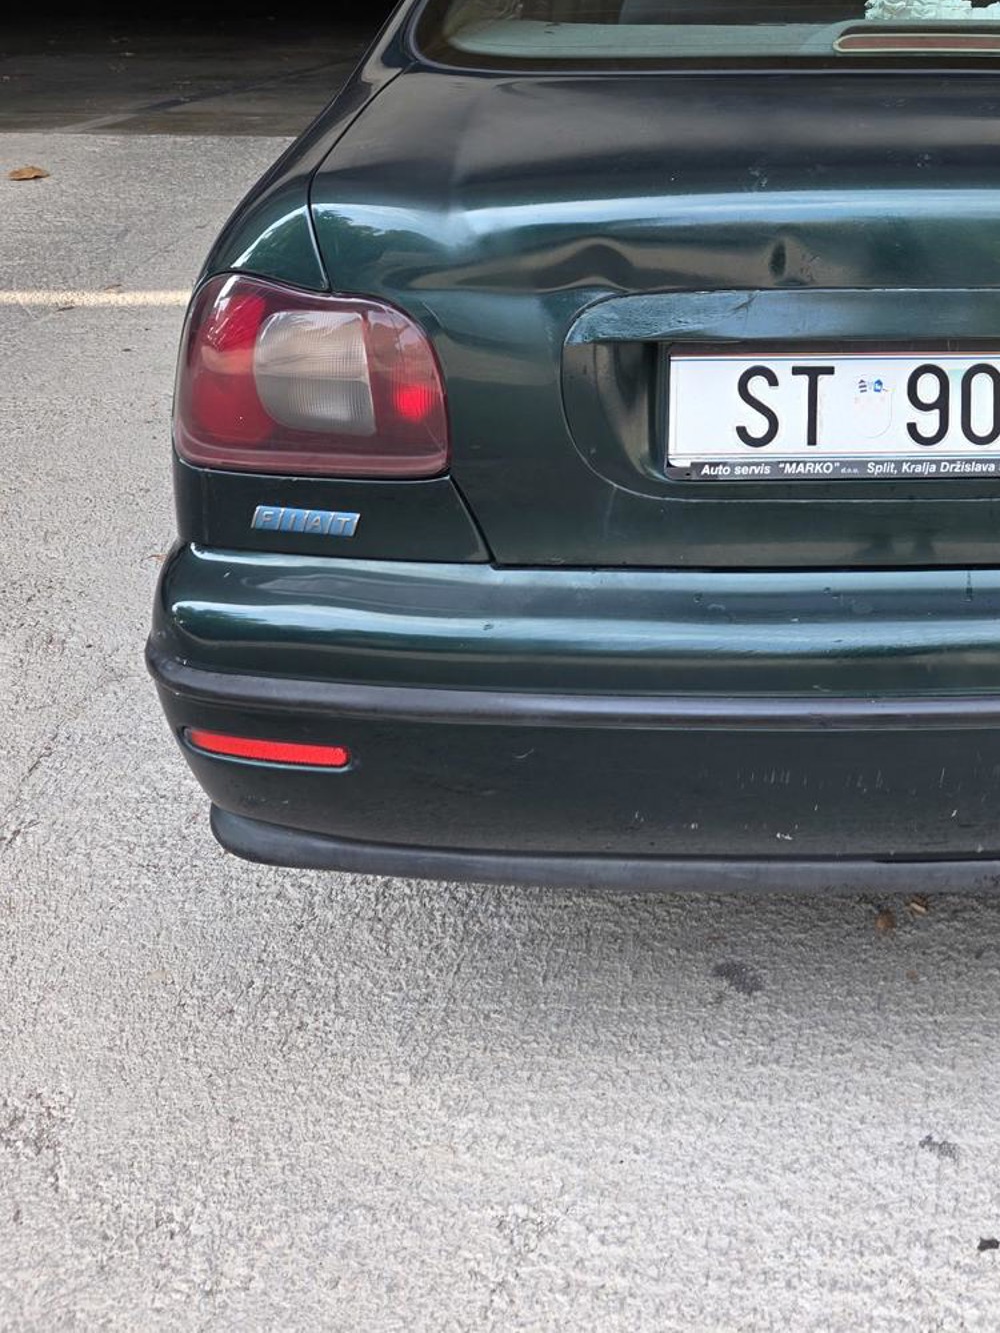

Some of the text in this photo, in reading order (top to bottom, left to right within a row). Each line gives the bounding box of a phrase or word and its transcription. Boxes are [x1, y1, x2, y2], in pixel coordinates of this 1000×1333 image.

[735, 365, 835, 448] ST
[701, 464, 731, 476] Auto
[734, 464, 771, 475] servis
[867, 462, 898, 475] Split,
[901, 462, 936, 474] Kralja
[940, 460, 996, 473] Držislava
[261, 510, 351, 534] FIAT
